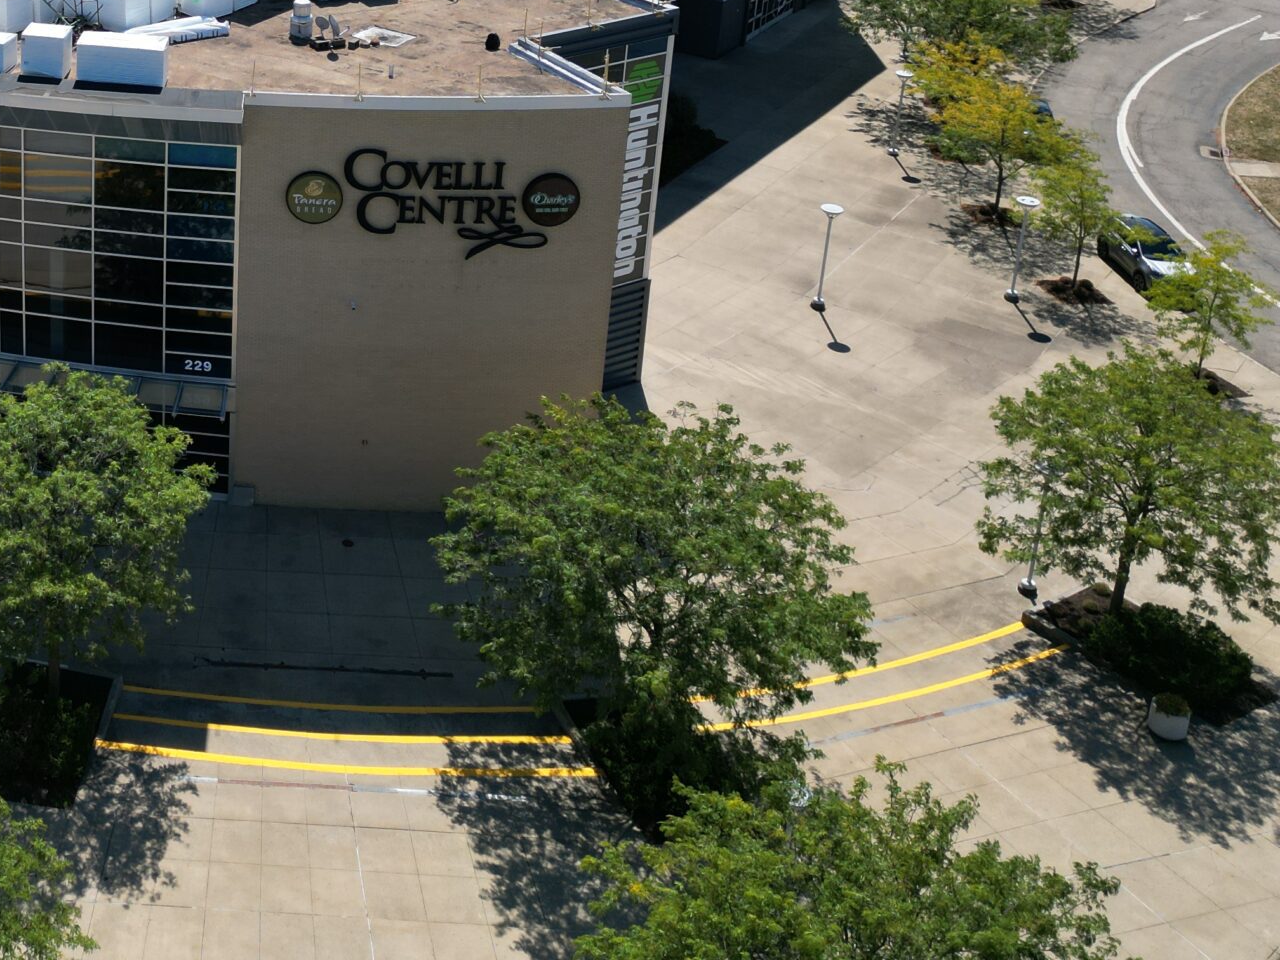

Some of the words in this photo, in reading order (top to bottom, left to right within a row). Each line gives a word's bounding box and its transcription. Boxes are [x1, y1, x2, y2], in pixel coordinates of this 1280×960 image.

[344, 148, 507, 191] COVELLI
[292, 193, 337, 206] Panera
[613, 104, 659, 278] Huntington
[356, 192, 523, 234] CENTRE
[184, 359, 212, 372] 229
